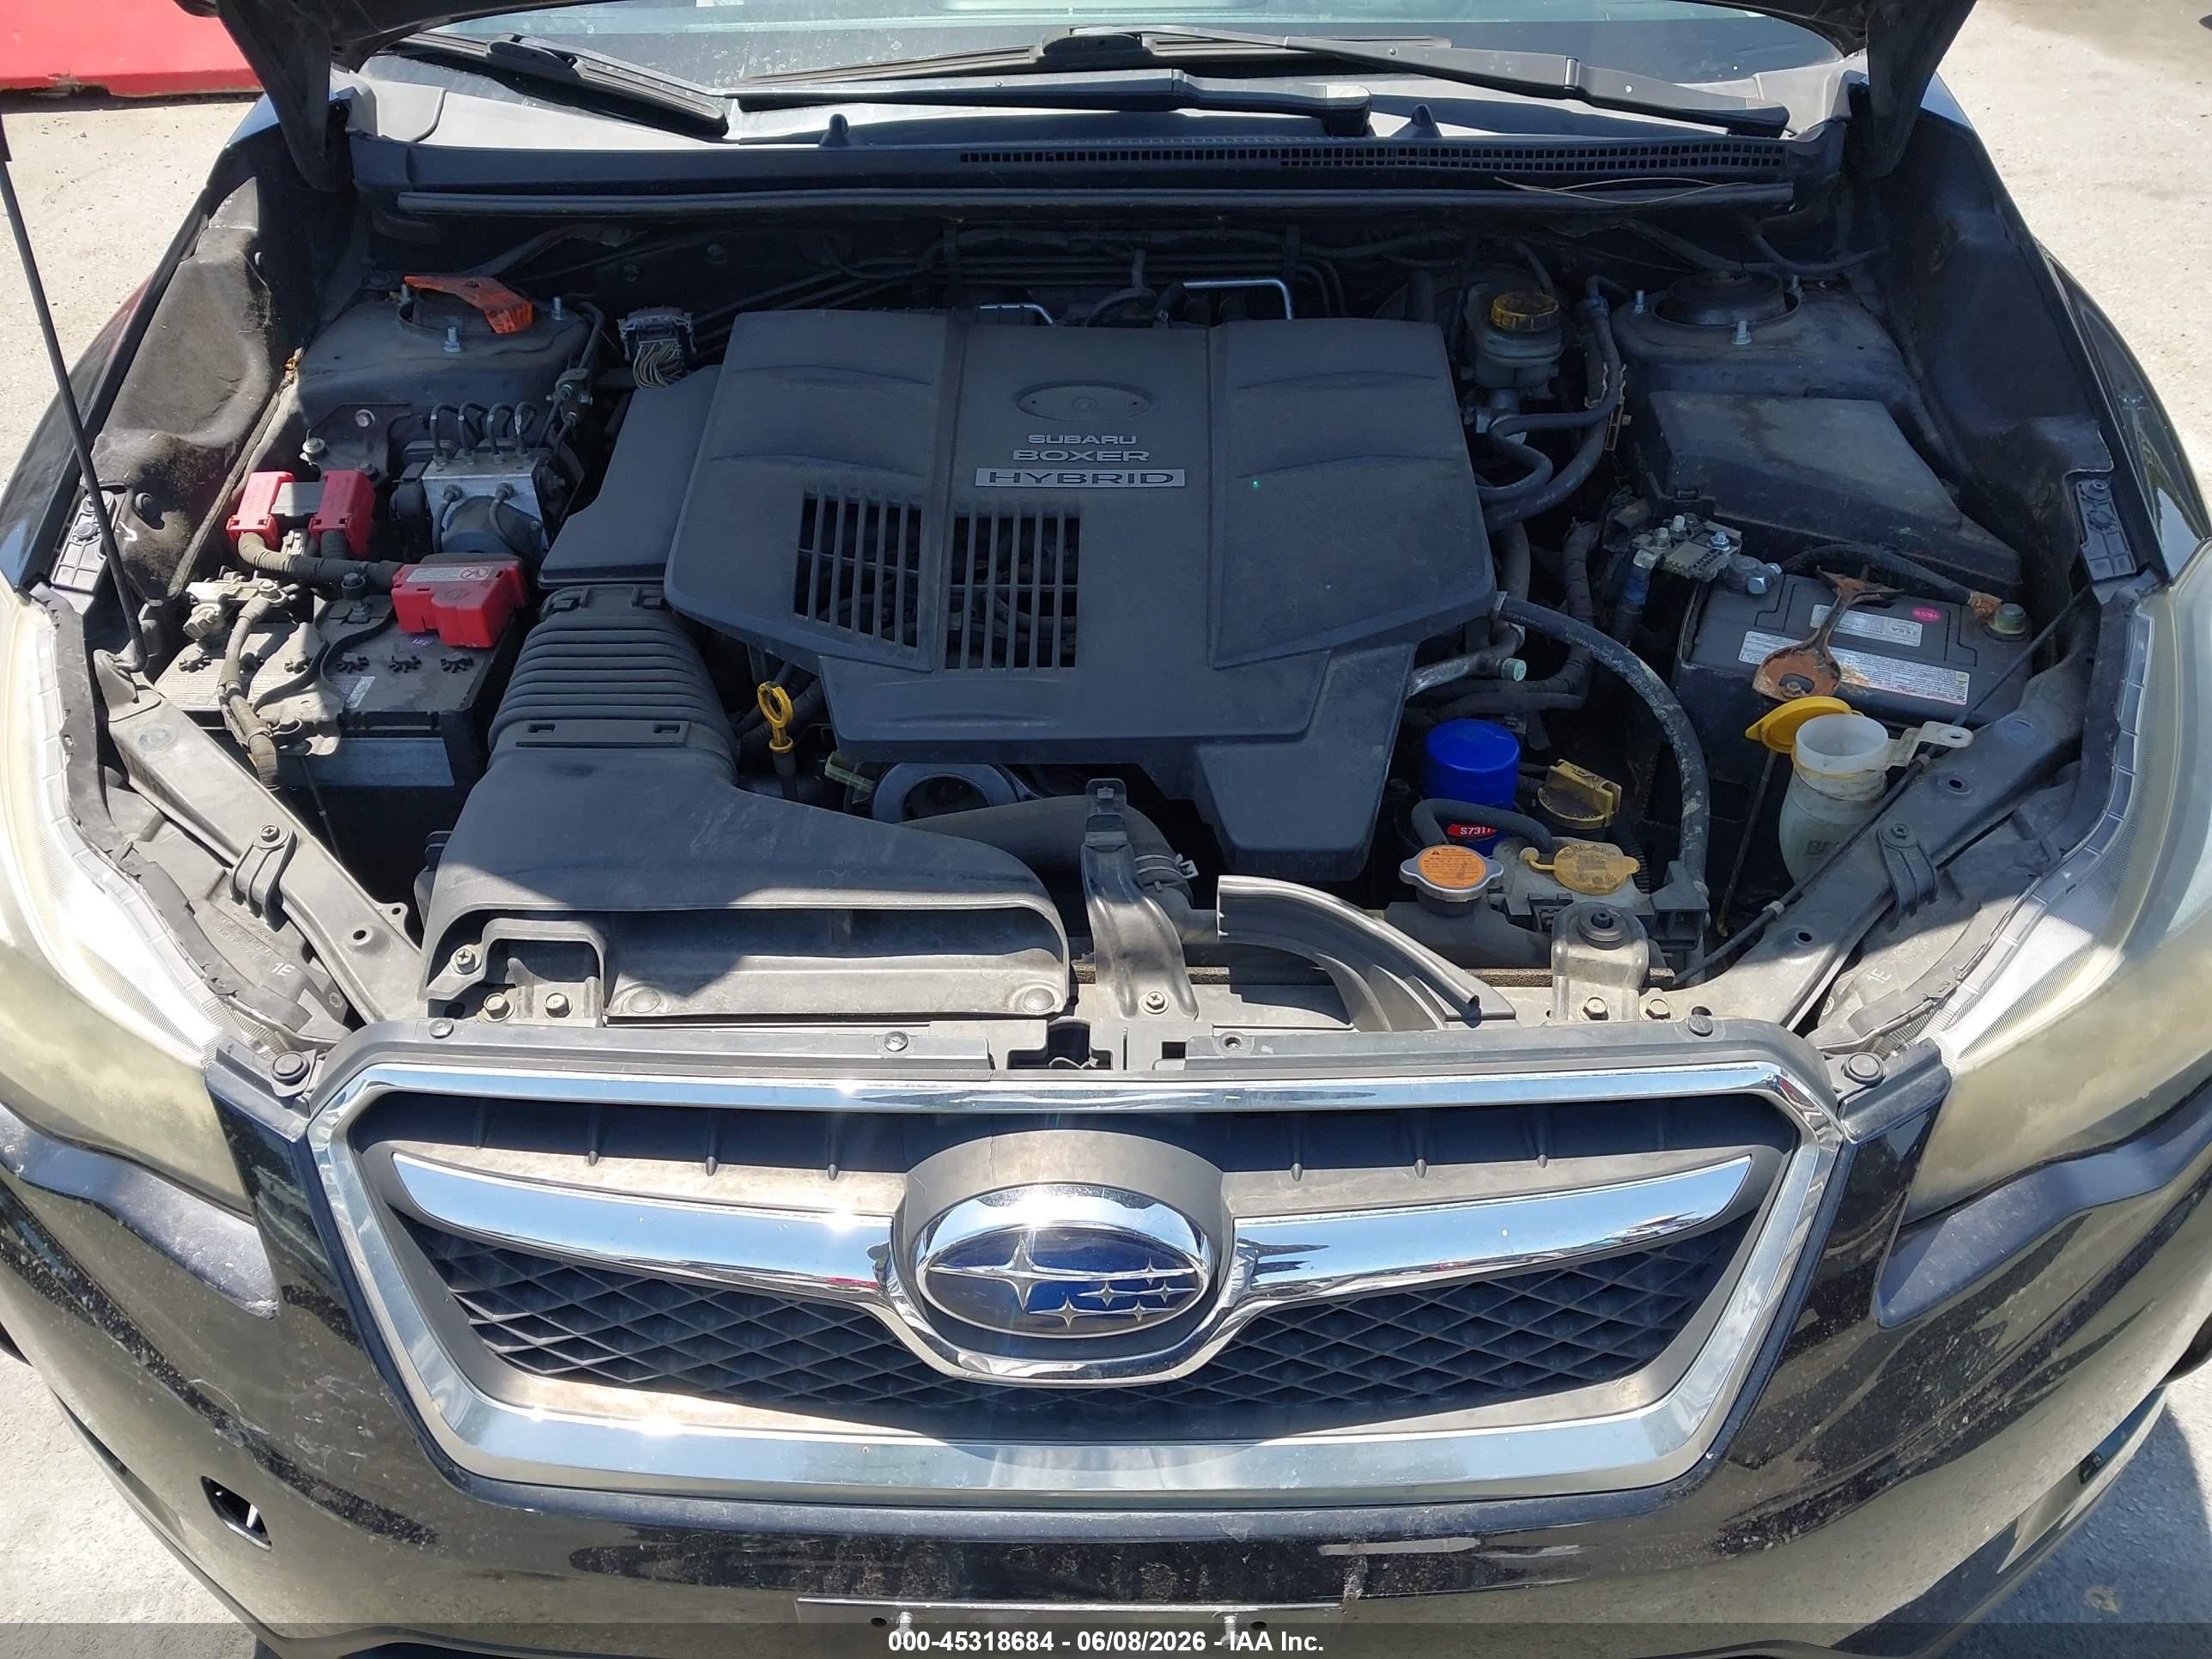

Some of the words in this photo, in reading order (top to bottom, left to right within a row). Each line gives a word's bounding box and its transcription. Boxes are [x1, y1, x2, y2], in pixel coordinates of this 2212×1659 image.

[1028, 434, 1137, 445] SUBARU
[1012, 450, 1151, 462] BOXER
[988, 472, 1175, 484] HYBRID
